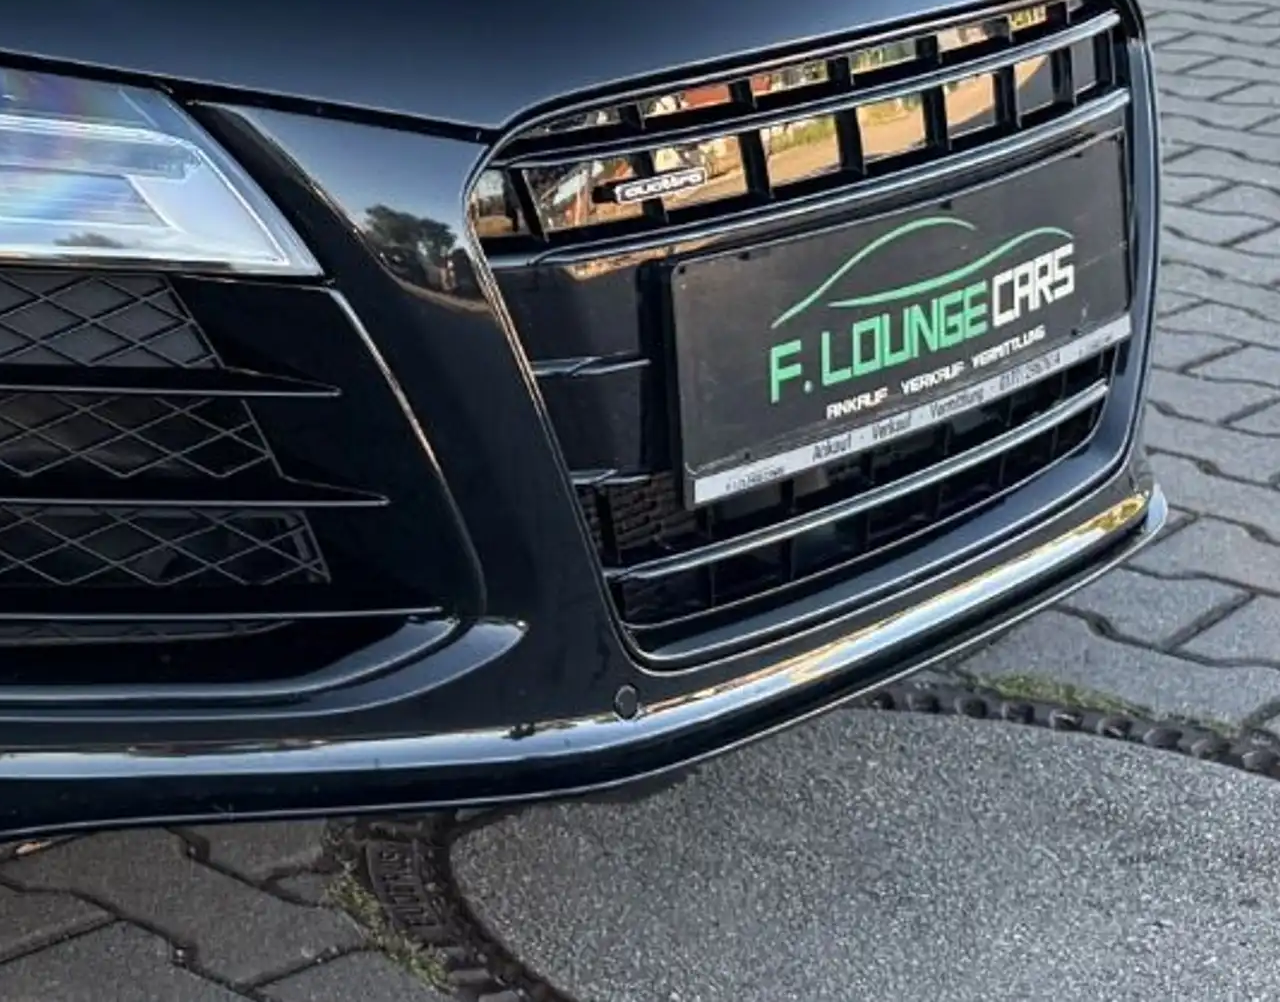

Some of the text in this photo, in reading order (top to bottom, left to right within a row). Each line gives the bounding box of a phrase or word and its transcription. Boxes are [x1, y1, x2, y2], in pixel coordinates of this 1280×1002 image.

[769, 339, 813, 404] F.
[826, 386, 889, 420] ANKAUF
[900, 359, 965, 395] VERKAUF
